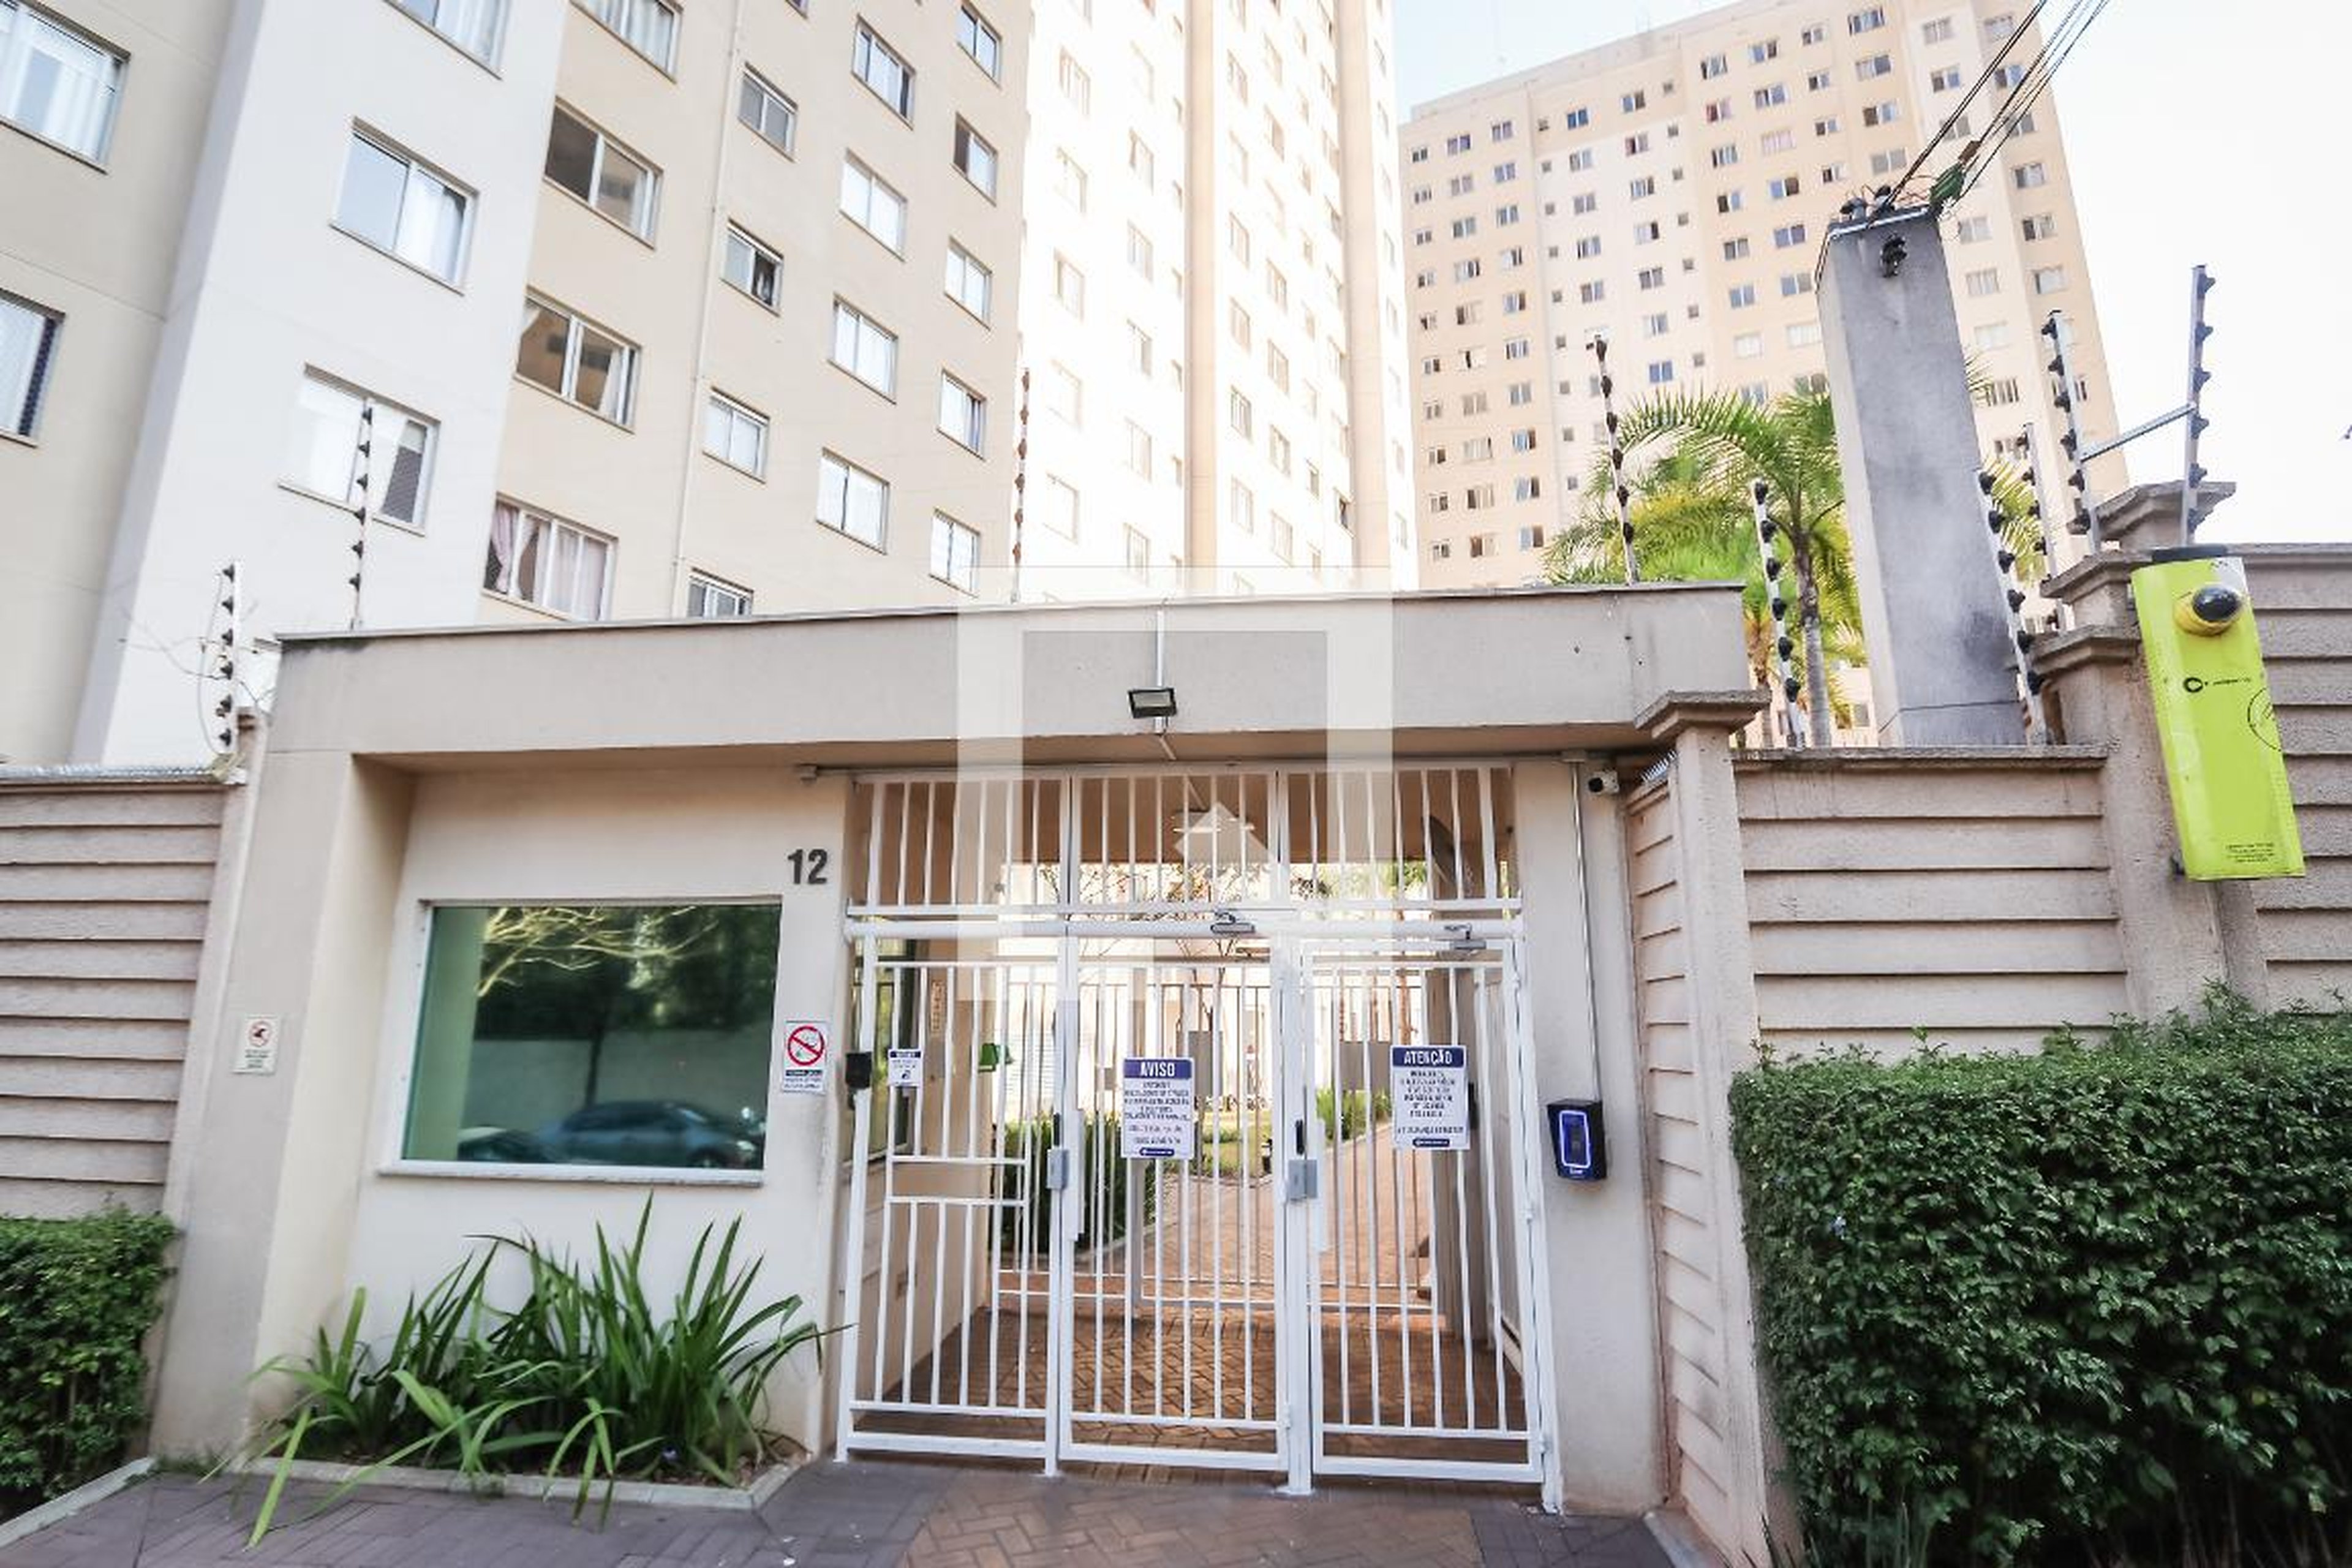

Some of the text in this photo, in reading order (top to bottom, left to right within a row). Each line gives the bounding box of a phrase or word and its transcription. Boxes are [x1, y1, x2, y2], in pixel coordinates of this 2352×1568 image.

[787, 848, 828, 885] 12
[1403, 1049, 1453, 1065] ATENÇÃO
[1140, 1061, 1175, 1077] AVISO
